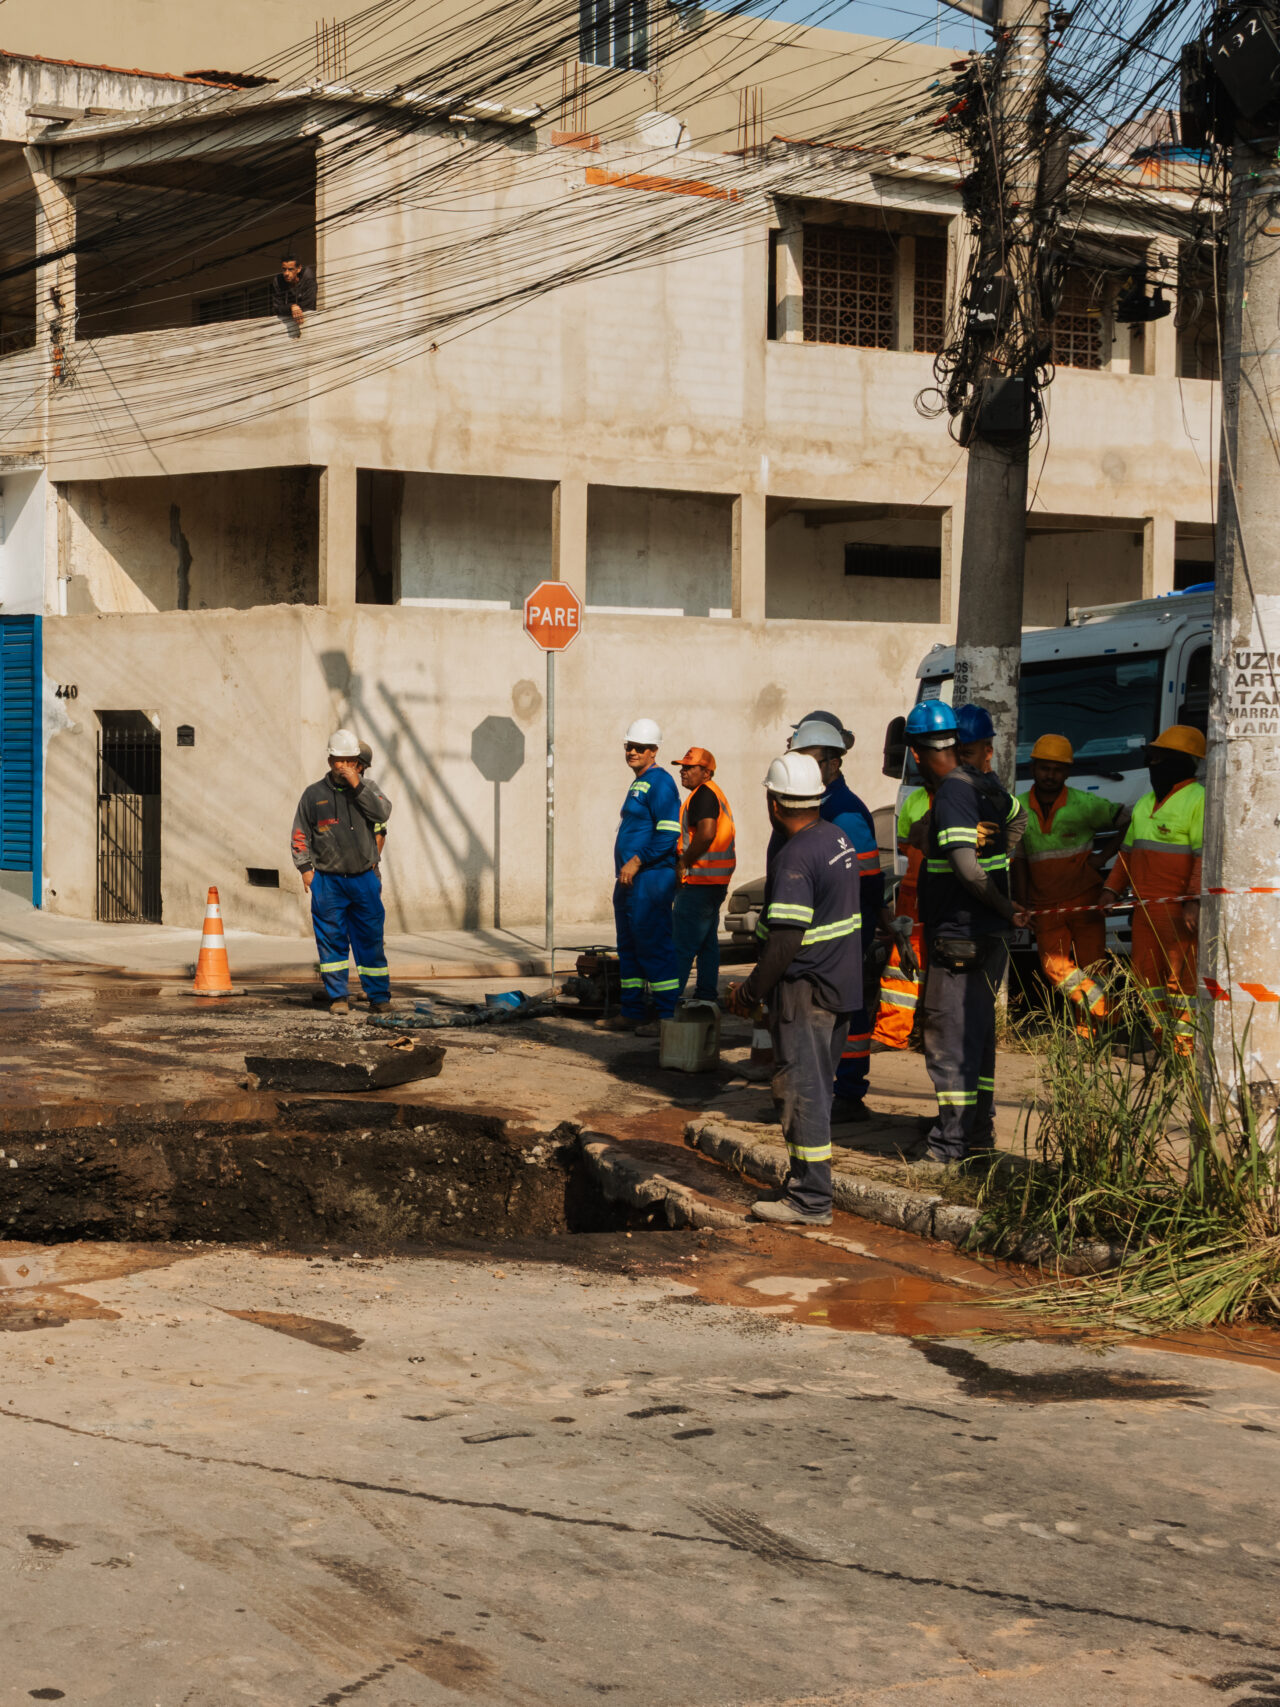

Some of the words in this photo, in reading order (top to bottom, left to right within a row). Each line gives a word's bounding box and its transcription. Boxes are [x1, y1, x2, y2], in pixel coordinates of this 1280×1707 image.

[529, 606, 577, 627] PARE
[1236, 652, 1280, 670] ÚZI
[1234, 673, 1280, 687] ART
[55, 684, 78, 699] 440
[1229, 707, 1280, 718] MARRA
[1242, 722, 1278, 734] AM
